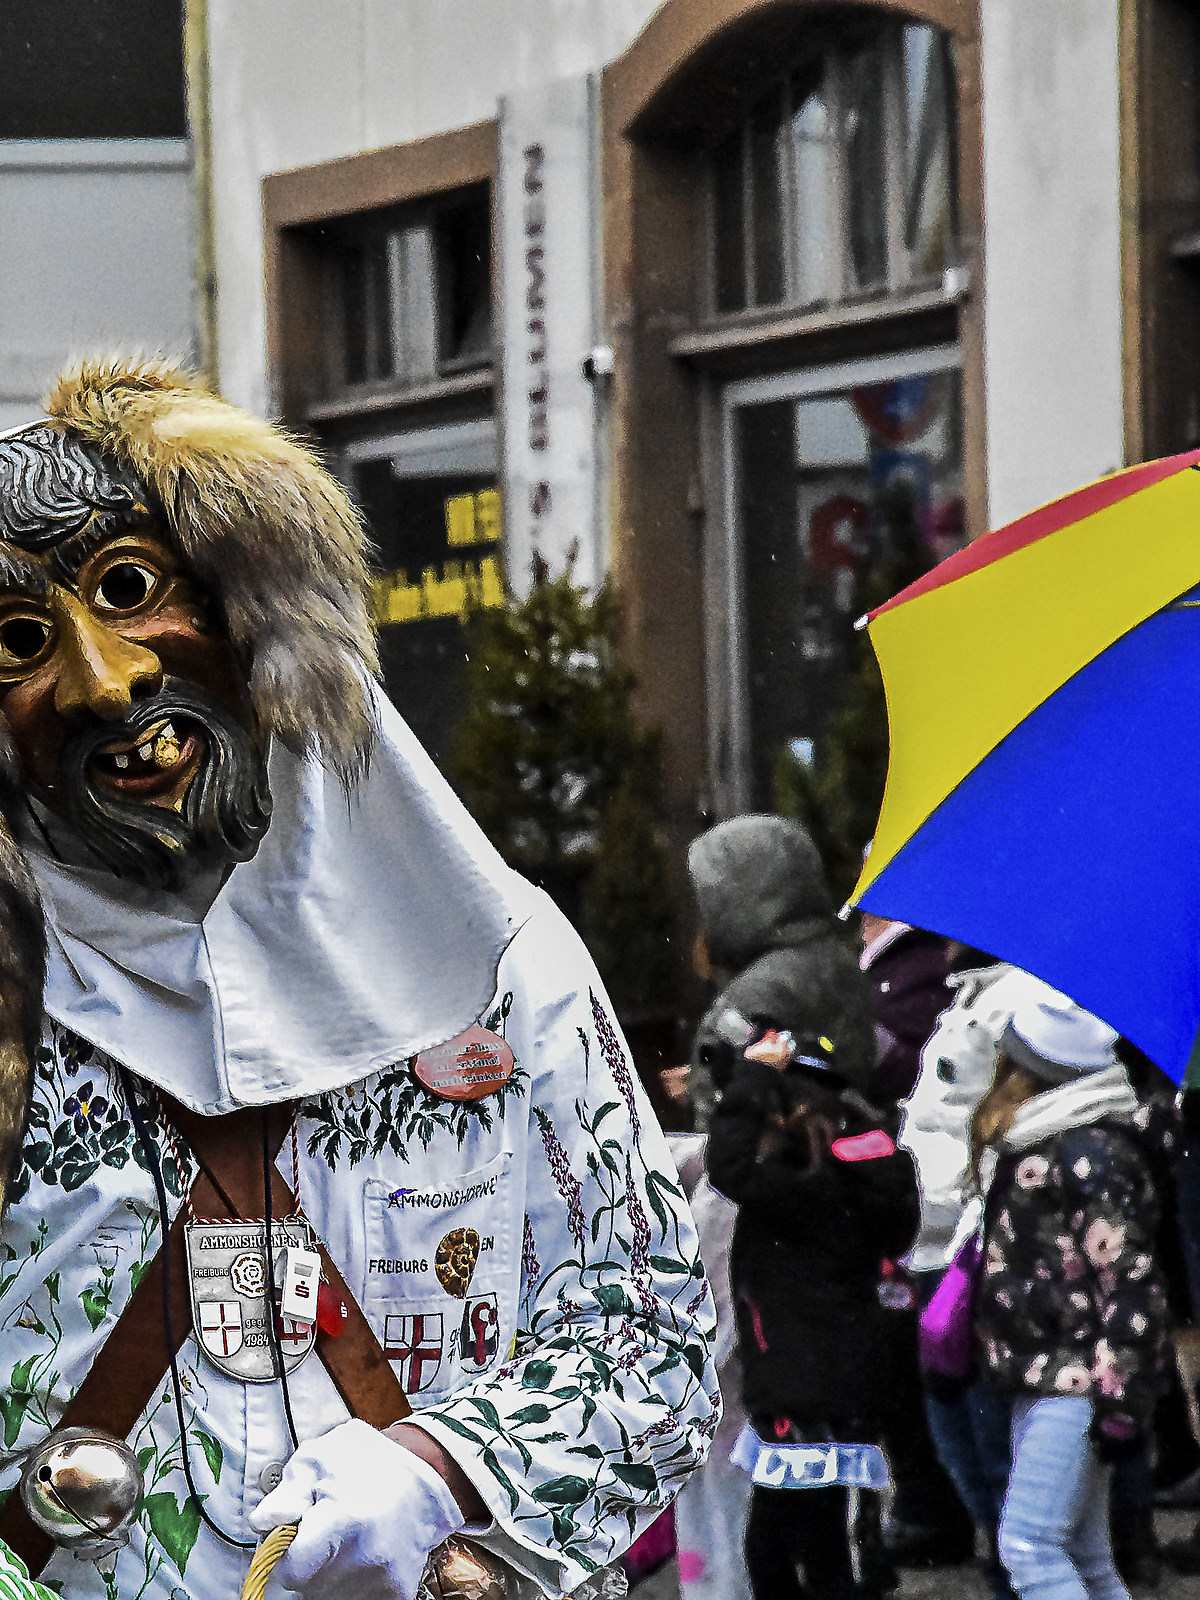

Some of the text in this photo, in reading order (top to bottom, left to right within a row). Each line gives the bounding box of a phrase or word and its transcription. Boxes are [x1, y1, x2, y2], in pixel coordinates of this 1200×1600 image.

[194, 1268, 230, 1278] FREIBURG
[369, 1259, 429, 1274] FREIBURG
[245, 1334, 270, 1348] 1984
